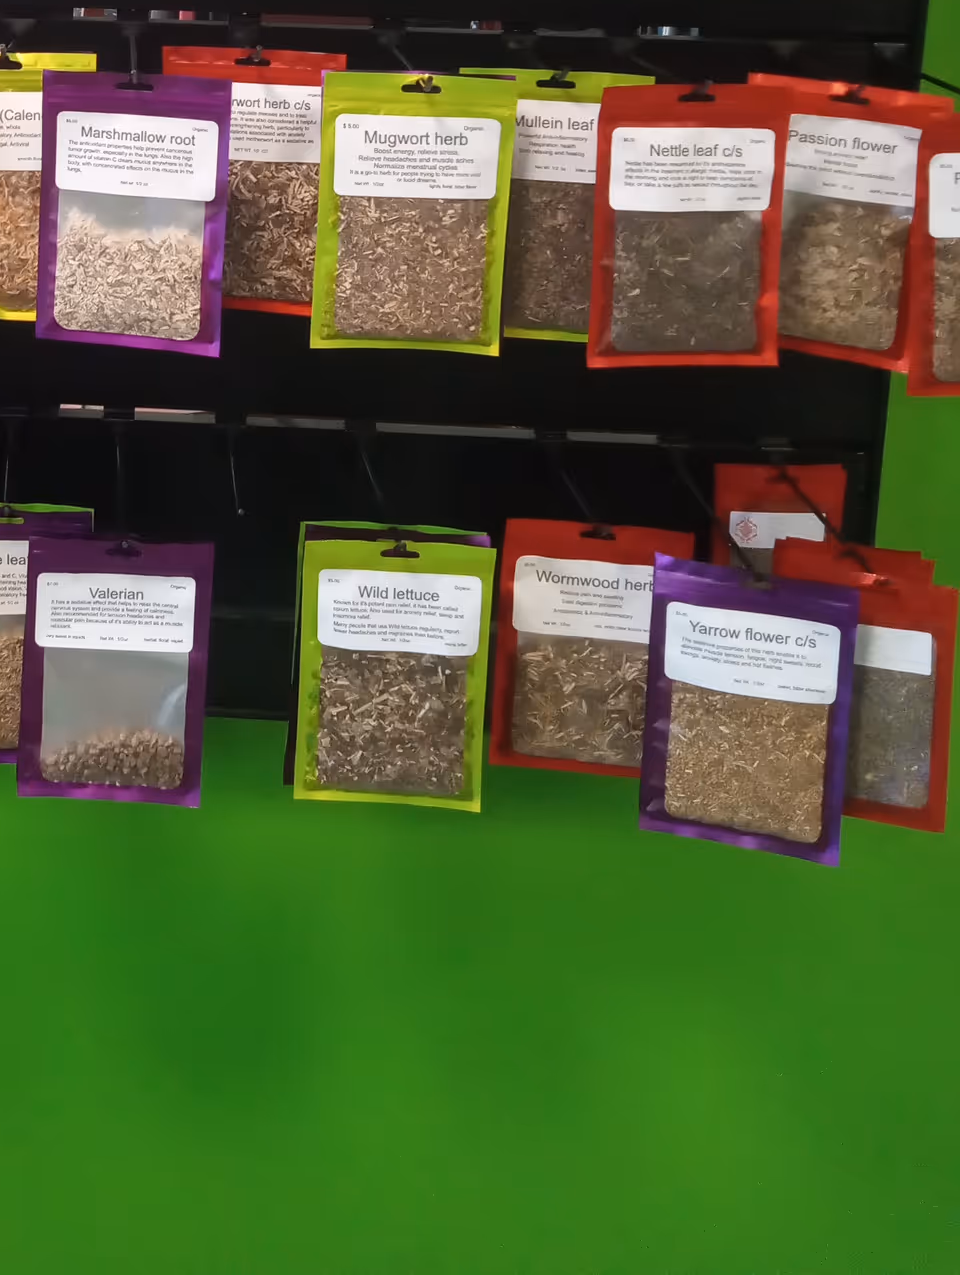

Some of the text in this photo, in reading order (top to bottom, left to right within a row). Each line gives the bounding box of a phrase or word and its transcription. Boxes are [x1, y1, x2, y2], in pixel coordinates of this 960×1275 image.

[264, 97, 291, 110] herb
[293, 100, 312, 111] c/s
[516, 115, 595, 131] Mullein leaf
[81, 125, 196, 147] Marshmallow root
[364, 129, 469, 148] Mugwort herb
[788, 129, 898, 156] Passion flower
[650, 143, 743, 158] Nettle leaf c/s
[6, 553, 29, 566] lea
[536, 568, 655, 592] Wormwood herb
[88, 587, 144, 601] Valerian
[358, 585, 440, 602] Wild lettuce
[689, 619, 817, 649] Yarrow flower c/s
